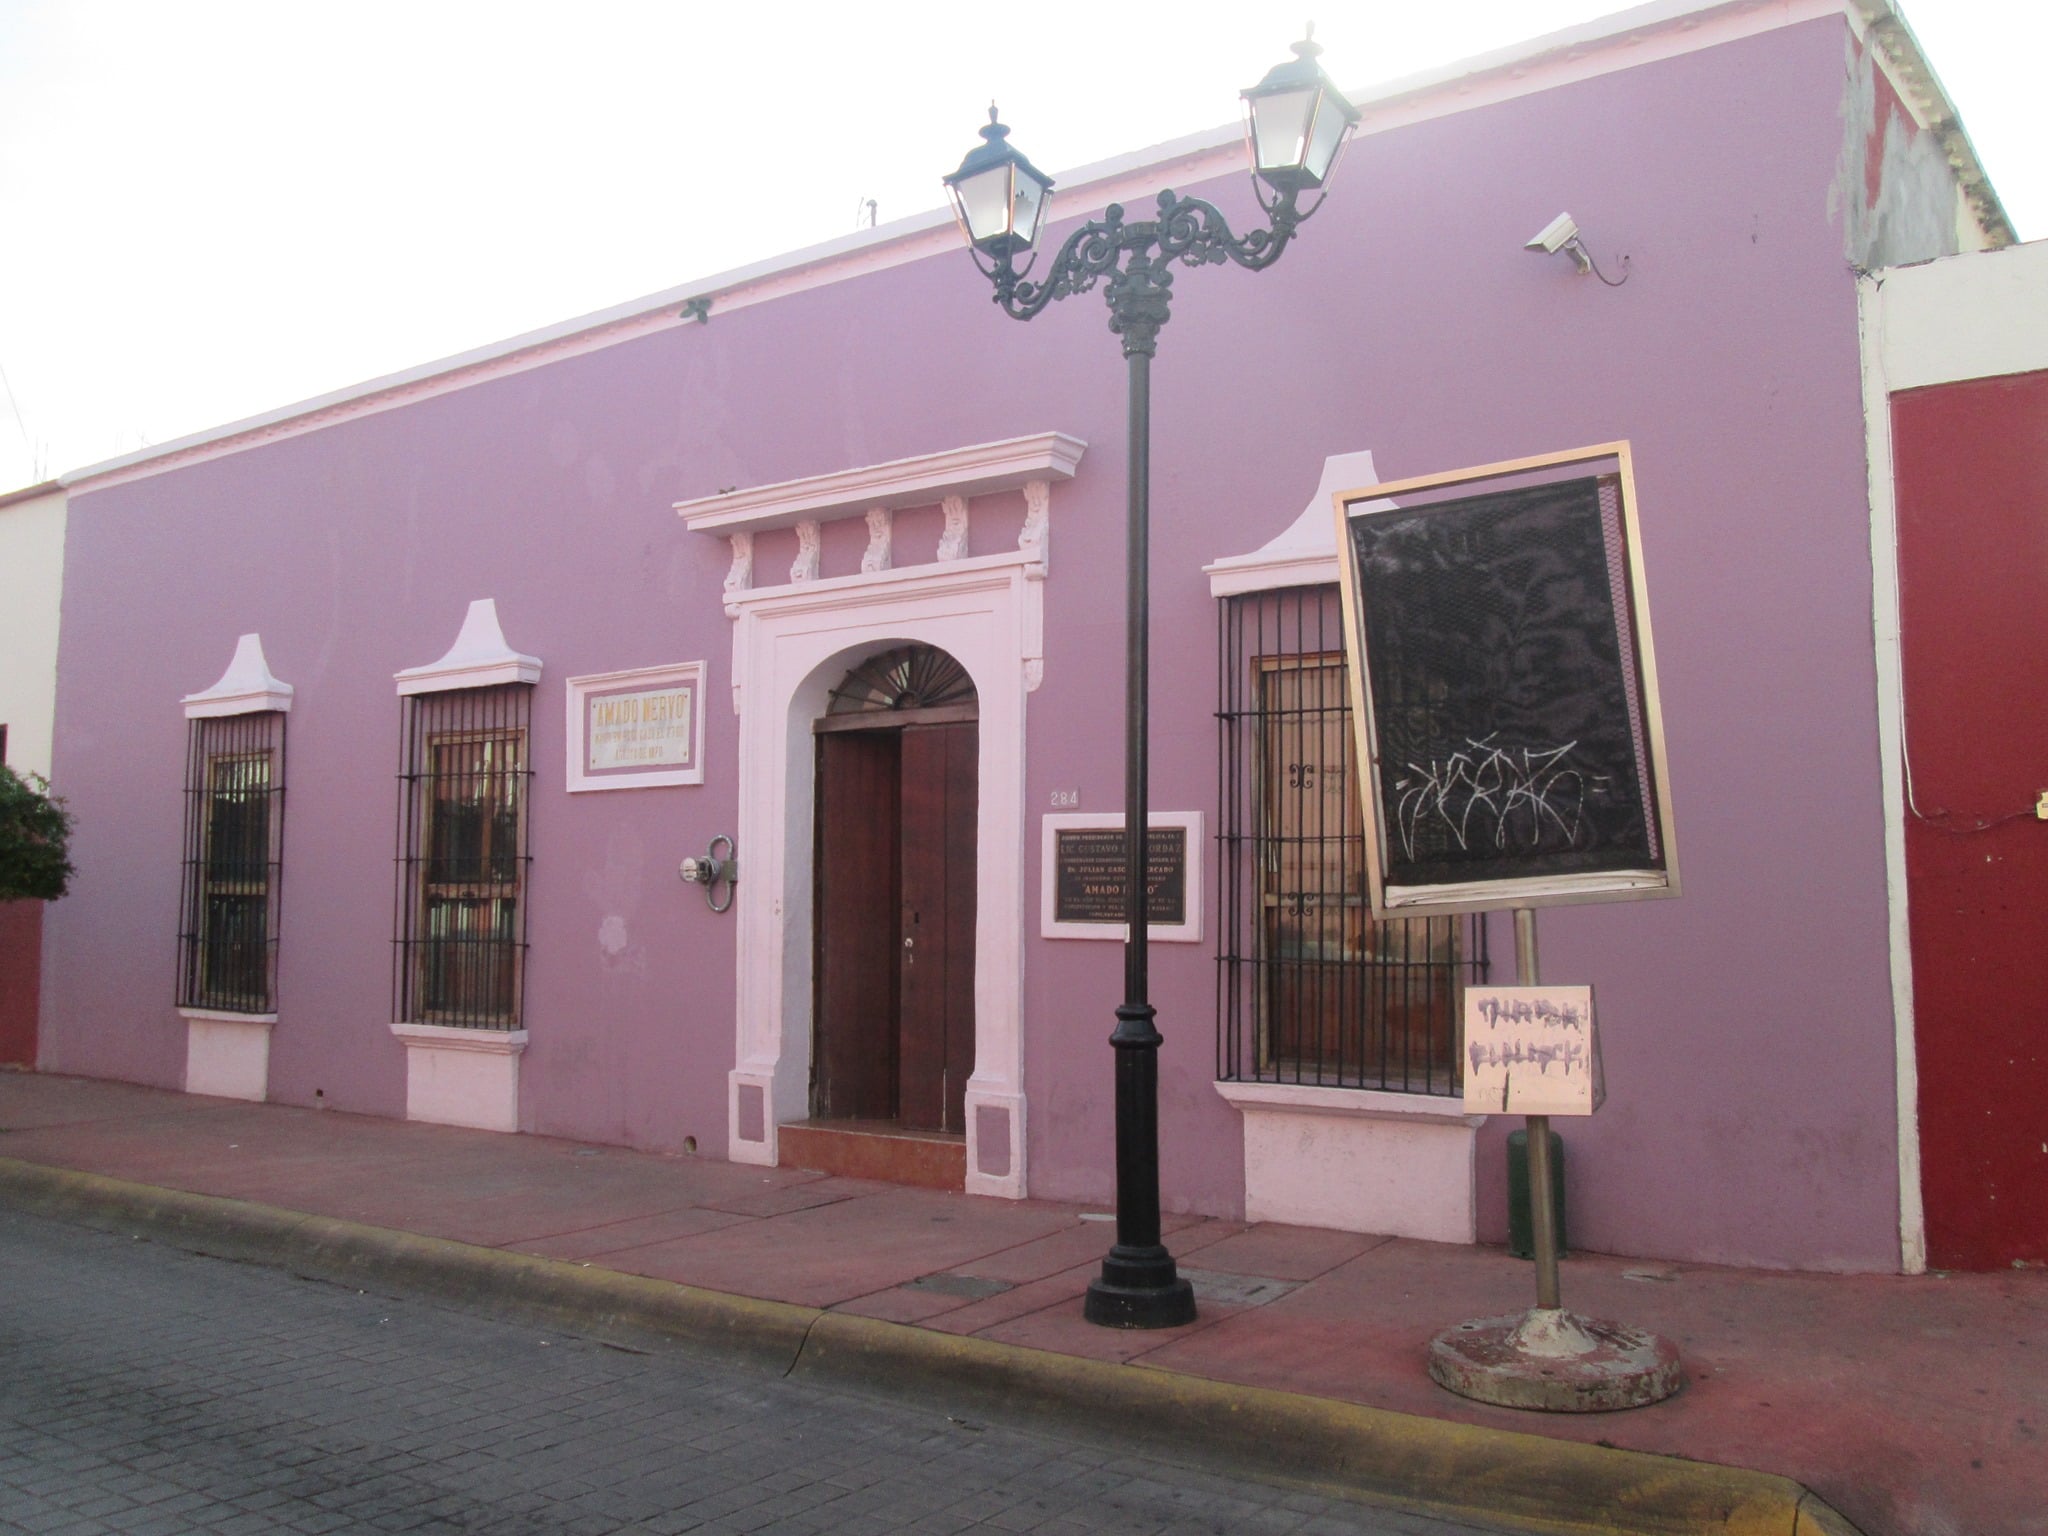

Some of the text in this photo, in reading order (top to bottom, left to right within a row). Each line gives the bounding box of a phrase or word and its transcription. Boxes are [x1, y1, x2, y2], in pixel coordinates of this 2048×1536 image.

[597, 694, 685, 727] AMADO NERVO
[1050, 791, 1078, 806] 284
